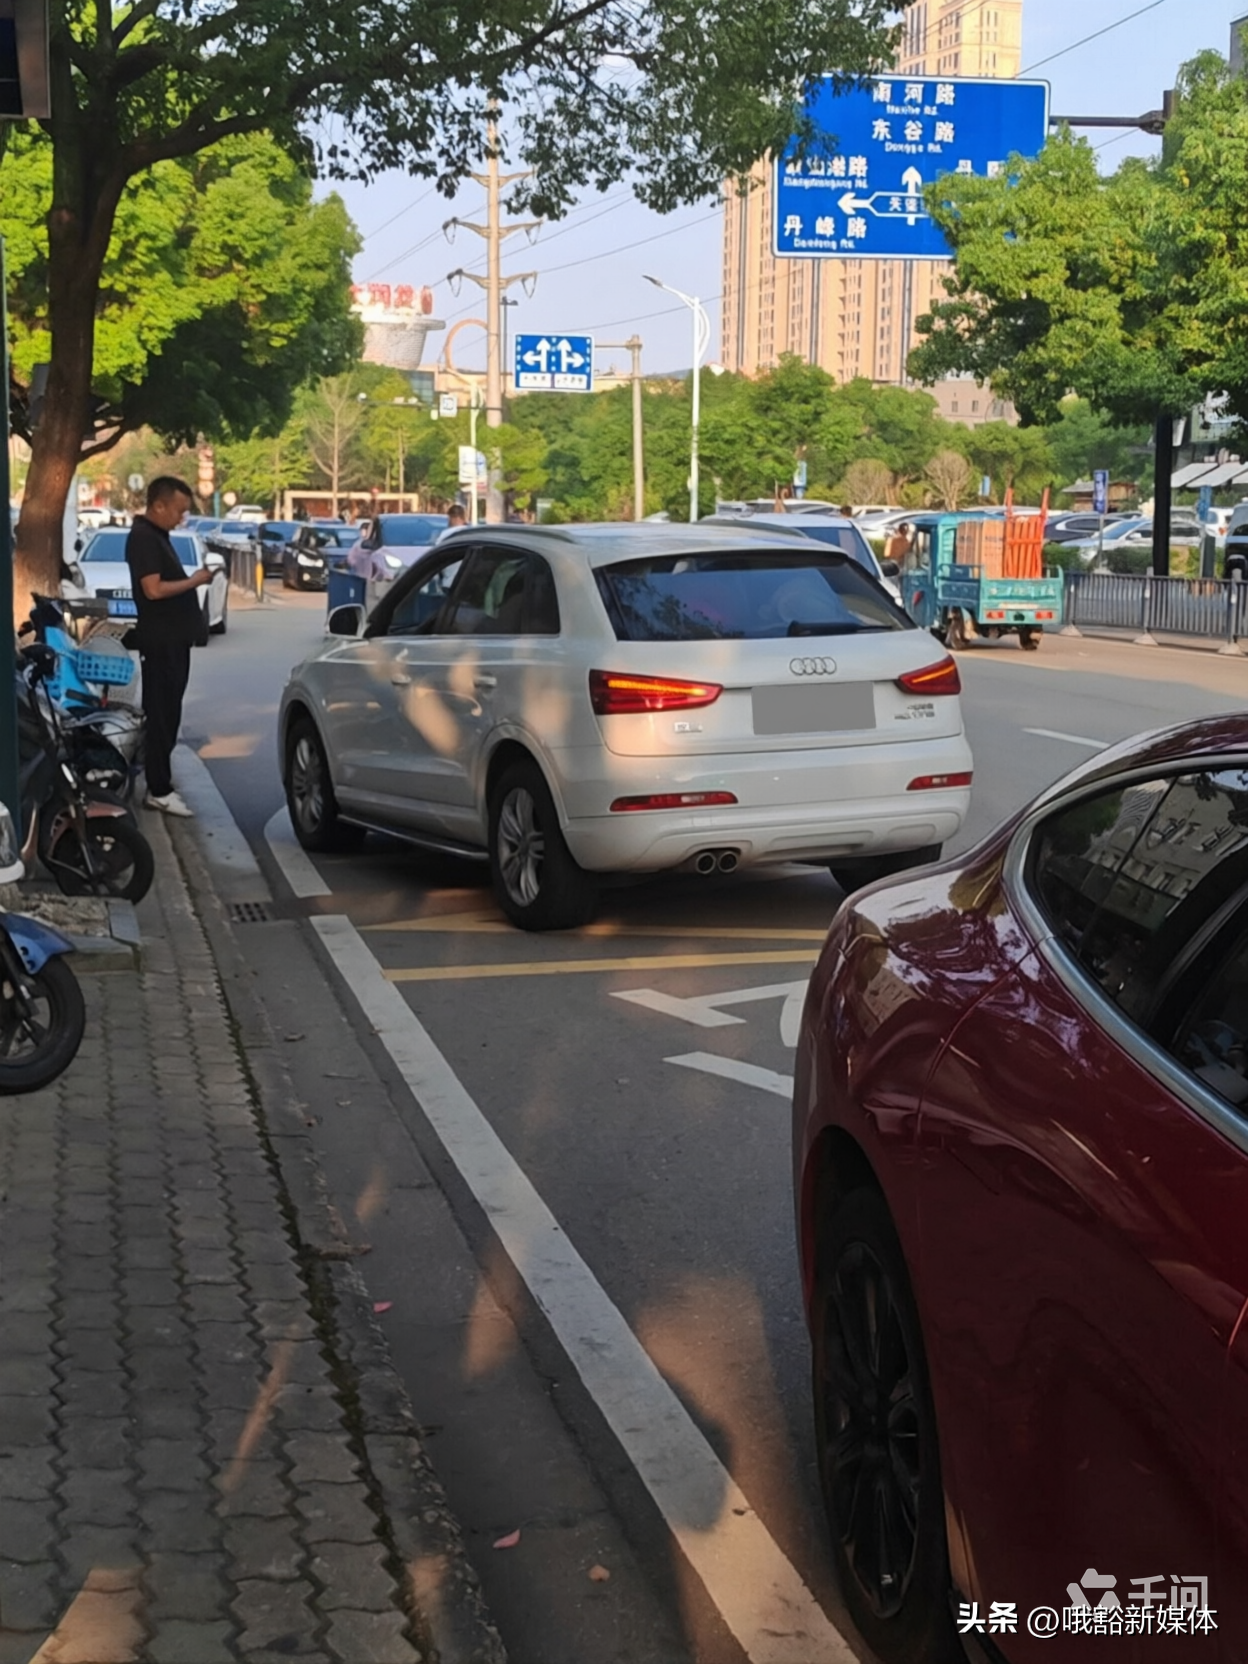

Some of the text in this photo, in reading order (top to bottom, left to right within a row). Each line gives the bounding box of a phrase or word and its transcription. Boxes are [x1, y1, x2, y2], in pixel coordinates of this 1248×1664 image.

[871, 118, 955, 143] 东谷路
[783, 214, 867, 239] 丹峰路
